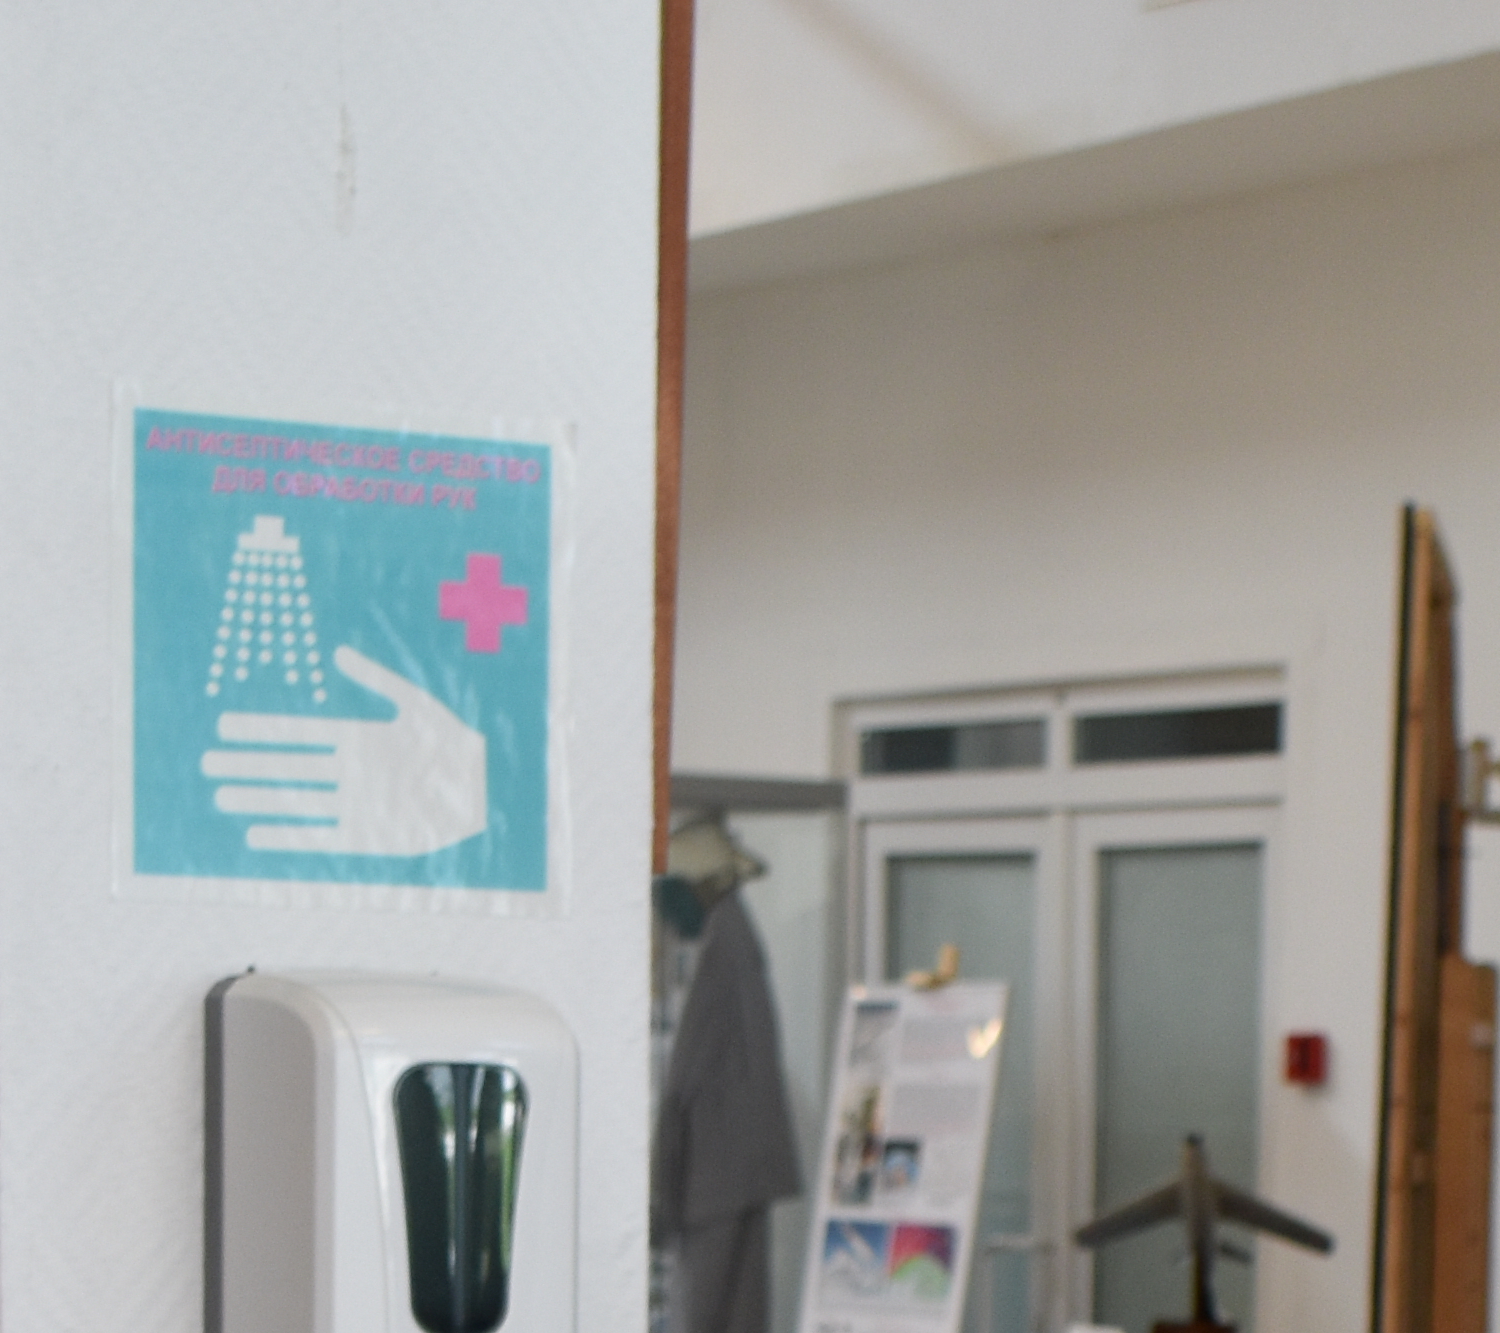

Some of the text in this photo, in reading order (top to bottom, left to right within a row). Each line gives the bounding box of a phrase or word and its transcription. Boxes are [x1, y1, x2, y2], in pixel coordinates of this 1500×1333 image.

[145, 425, 542, 484] АНТИСЕПТИЧЕСКОЕ СРЕДСТВО
[212, 465, 478, 511] ДЛЯ ОБРАБОТКИ РУК
